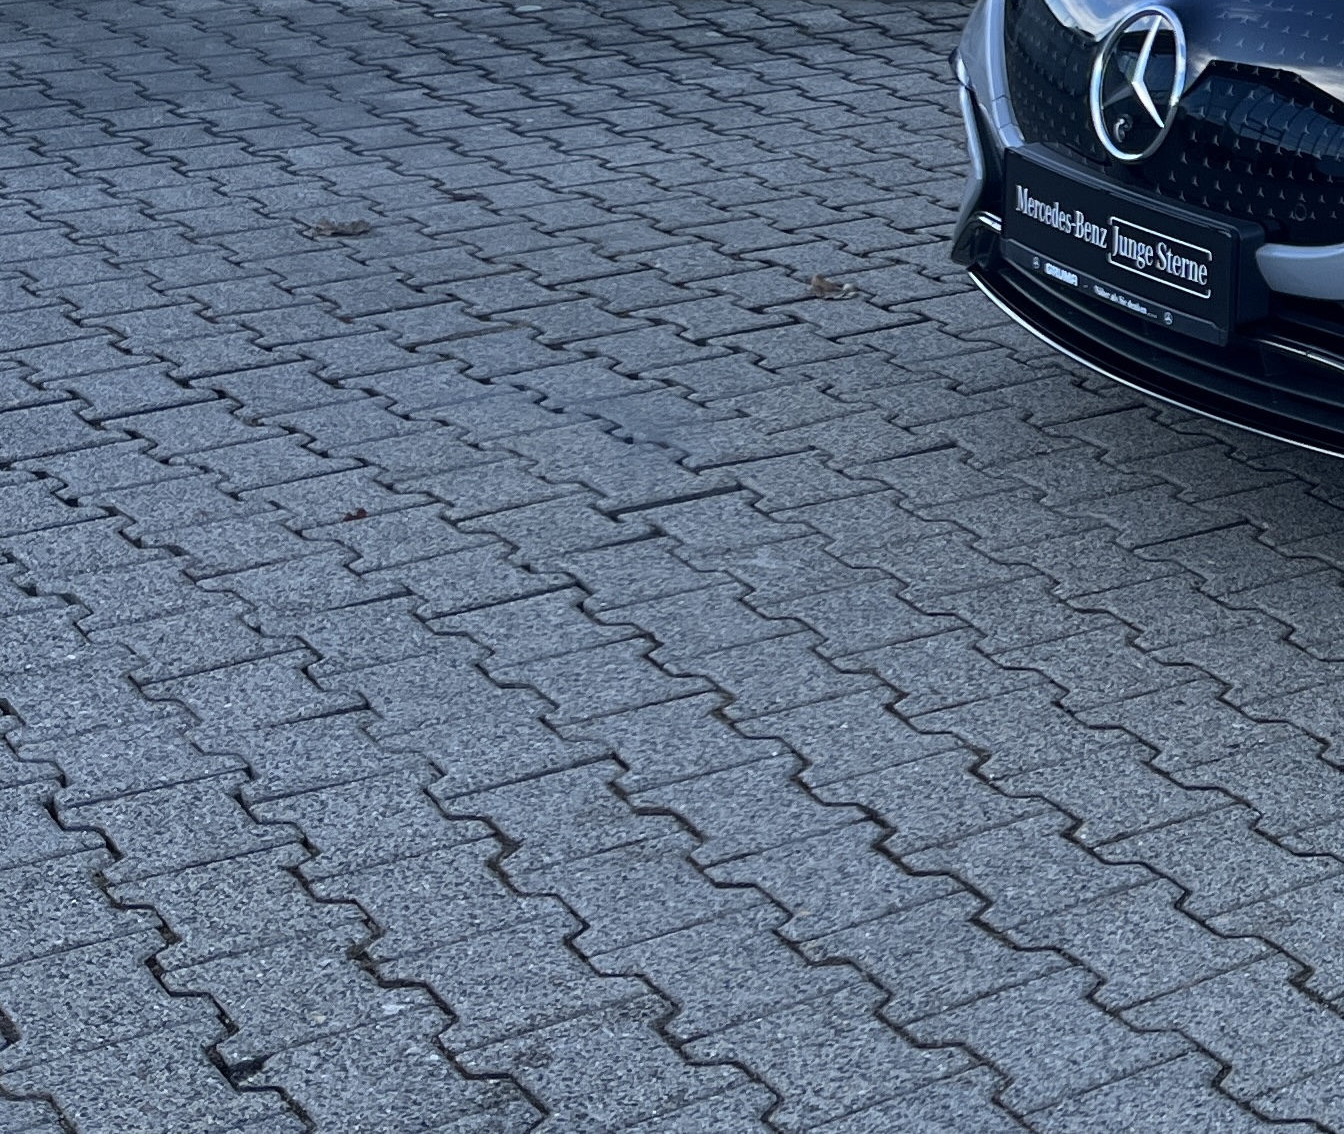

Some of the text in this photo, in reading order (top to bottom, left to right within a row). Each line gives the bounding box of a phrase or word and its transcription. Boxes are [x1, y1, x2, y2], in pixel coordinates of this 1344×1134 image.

[1015, 184, 1208, 286] Mercedes-Benz Junge Sterne
